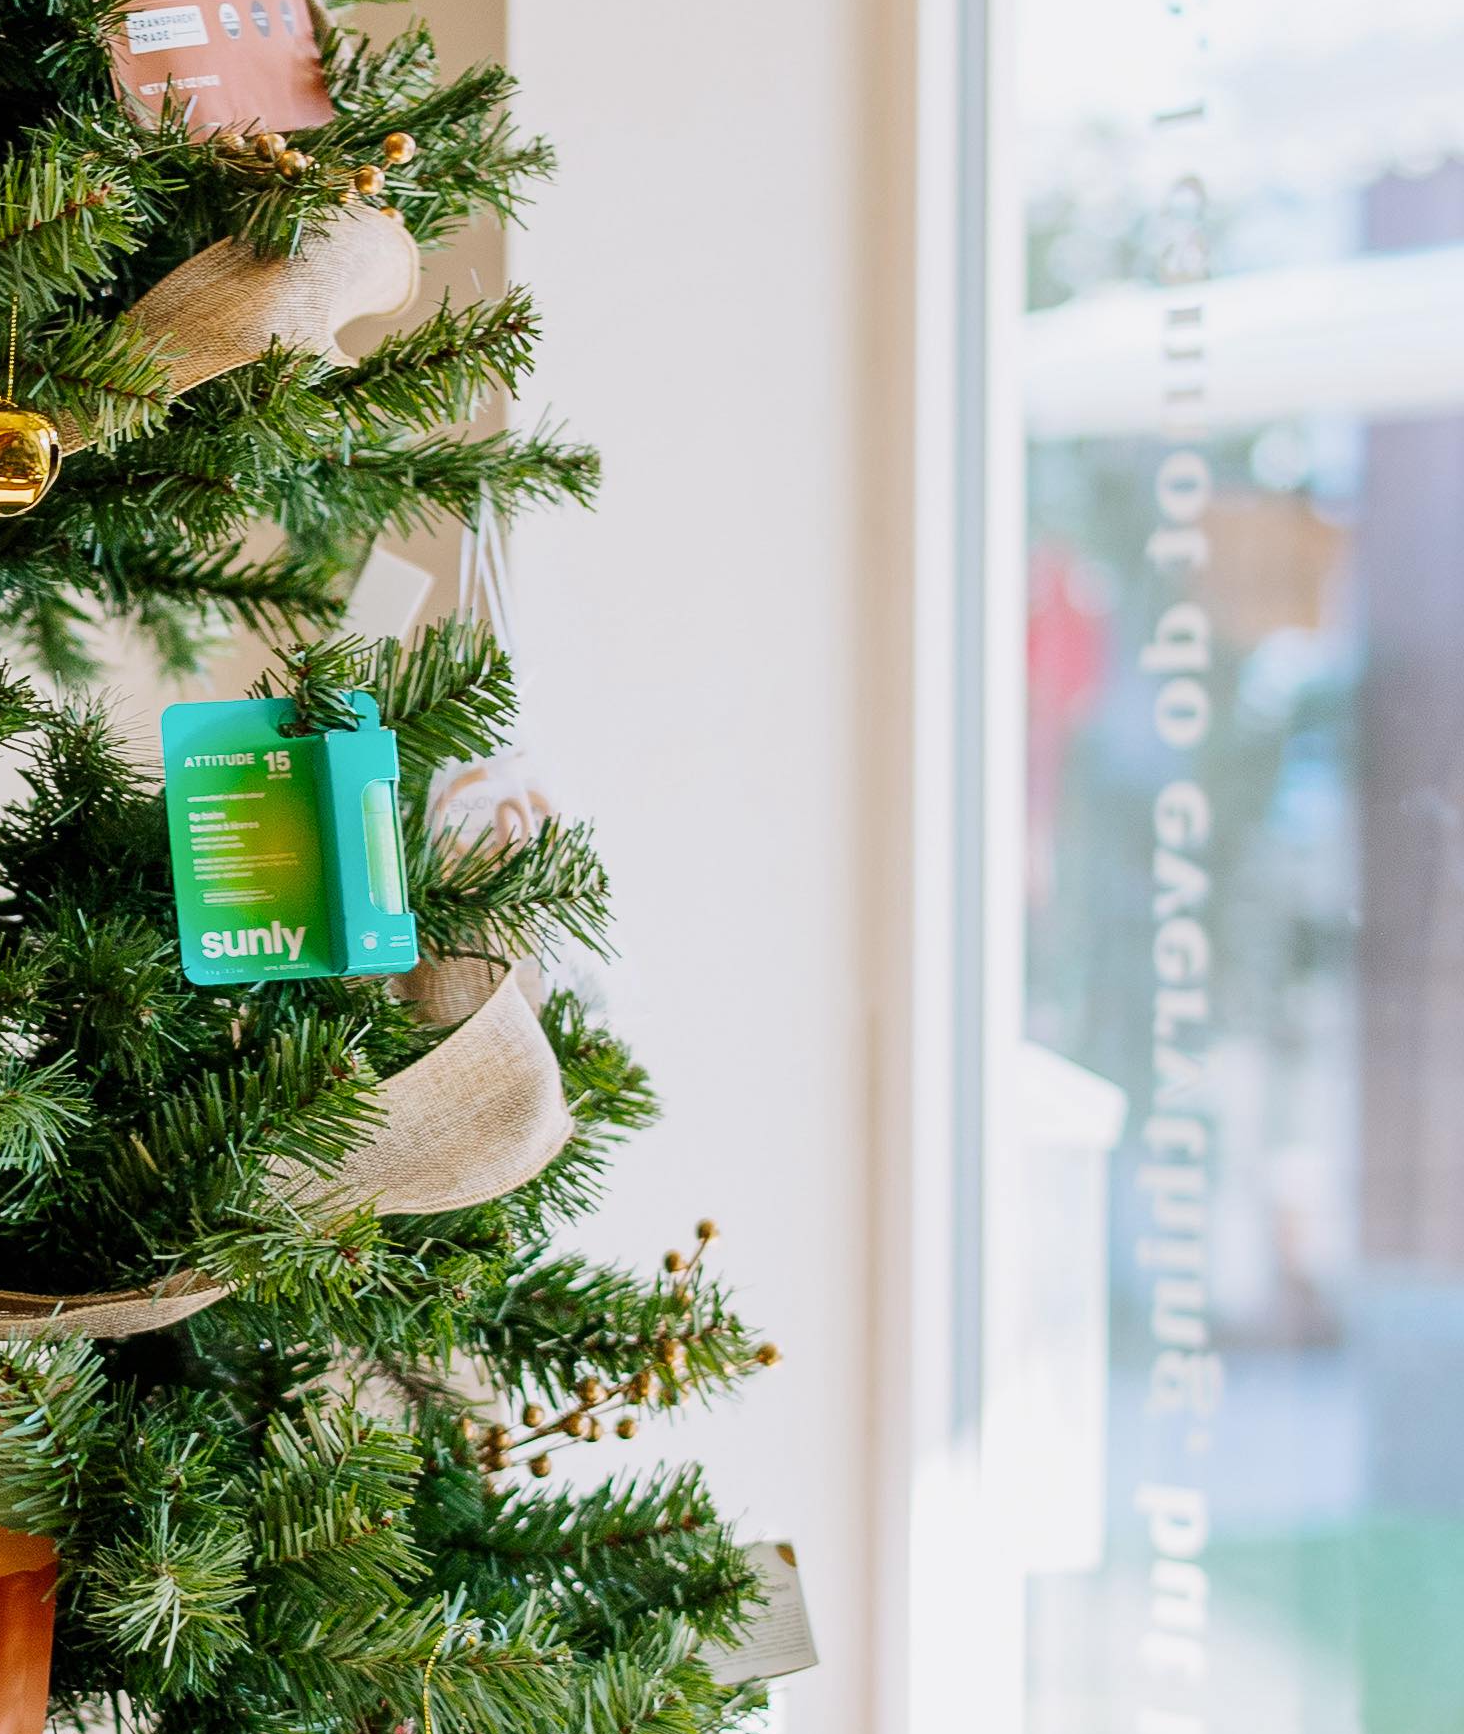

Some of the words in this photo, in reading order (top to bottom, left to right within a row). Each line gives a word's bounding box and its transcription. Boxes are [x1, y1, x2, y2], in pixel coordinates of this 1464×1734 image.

[184, 753, 256, 769] ATTITUDE
[263, 750, 292, 773] 15
[200, 920, 308, 962] sunly
